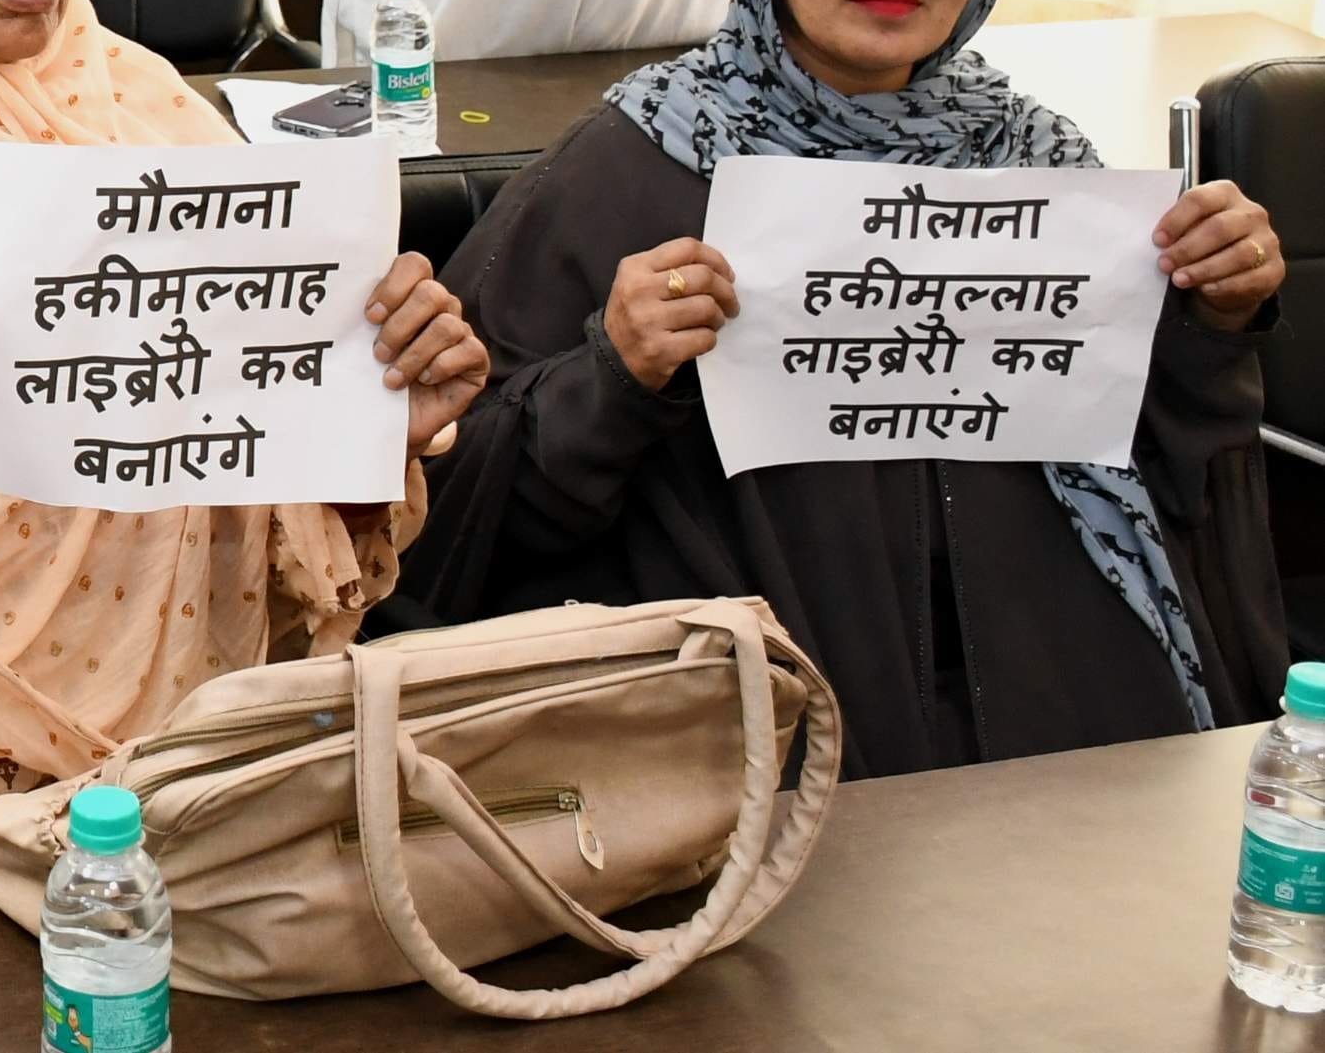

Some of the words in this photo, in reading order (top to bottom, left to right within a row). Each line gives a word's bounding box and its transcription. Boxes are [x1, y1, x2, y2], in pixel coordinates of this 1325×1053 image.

[96, 168, 301, 234] मौलाना
[862, 182, 1050, 239] मौलाना
[34, 253, 339, 342] हकीमुल्लाह
[803, 256, 1090, 331] हकीमुल्लाह
[14, 336, 211, 413] लाइब्रेरी
[240, 340, 334, 390] कब
[782, 325, 965, 383] लाइब्रेरी
[992, 338, 1084, 377] कब
[828, 387, 1009, 442] बनाएंगे
[73, 413, 265, 487] बनाएंगे
